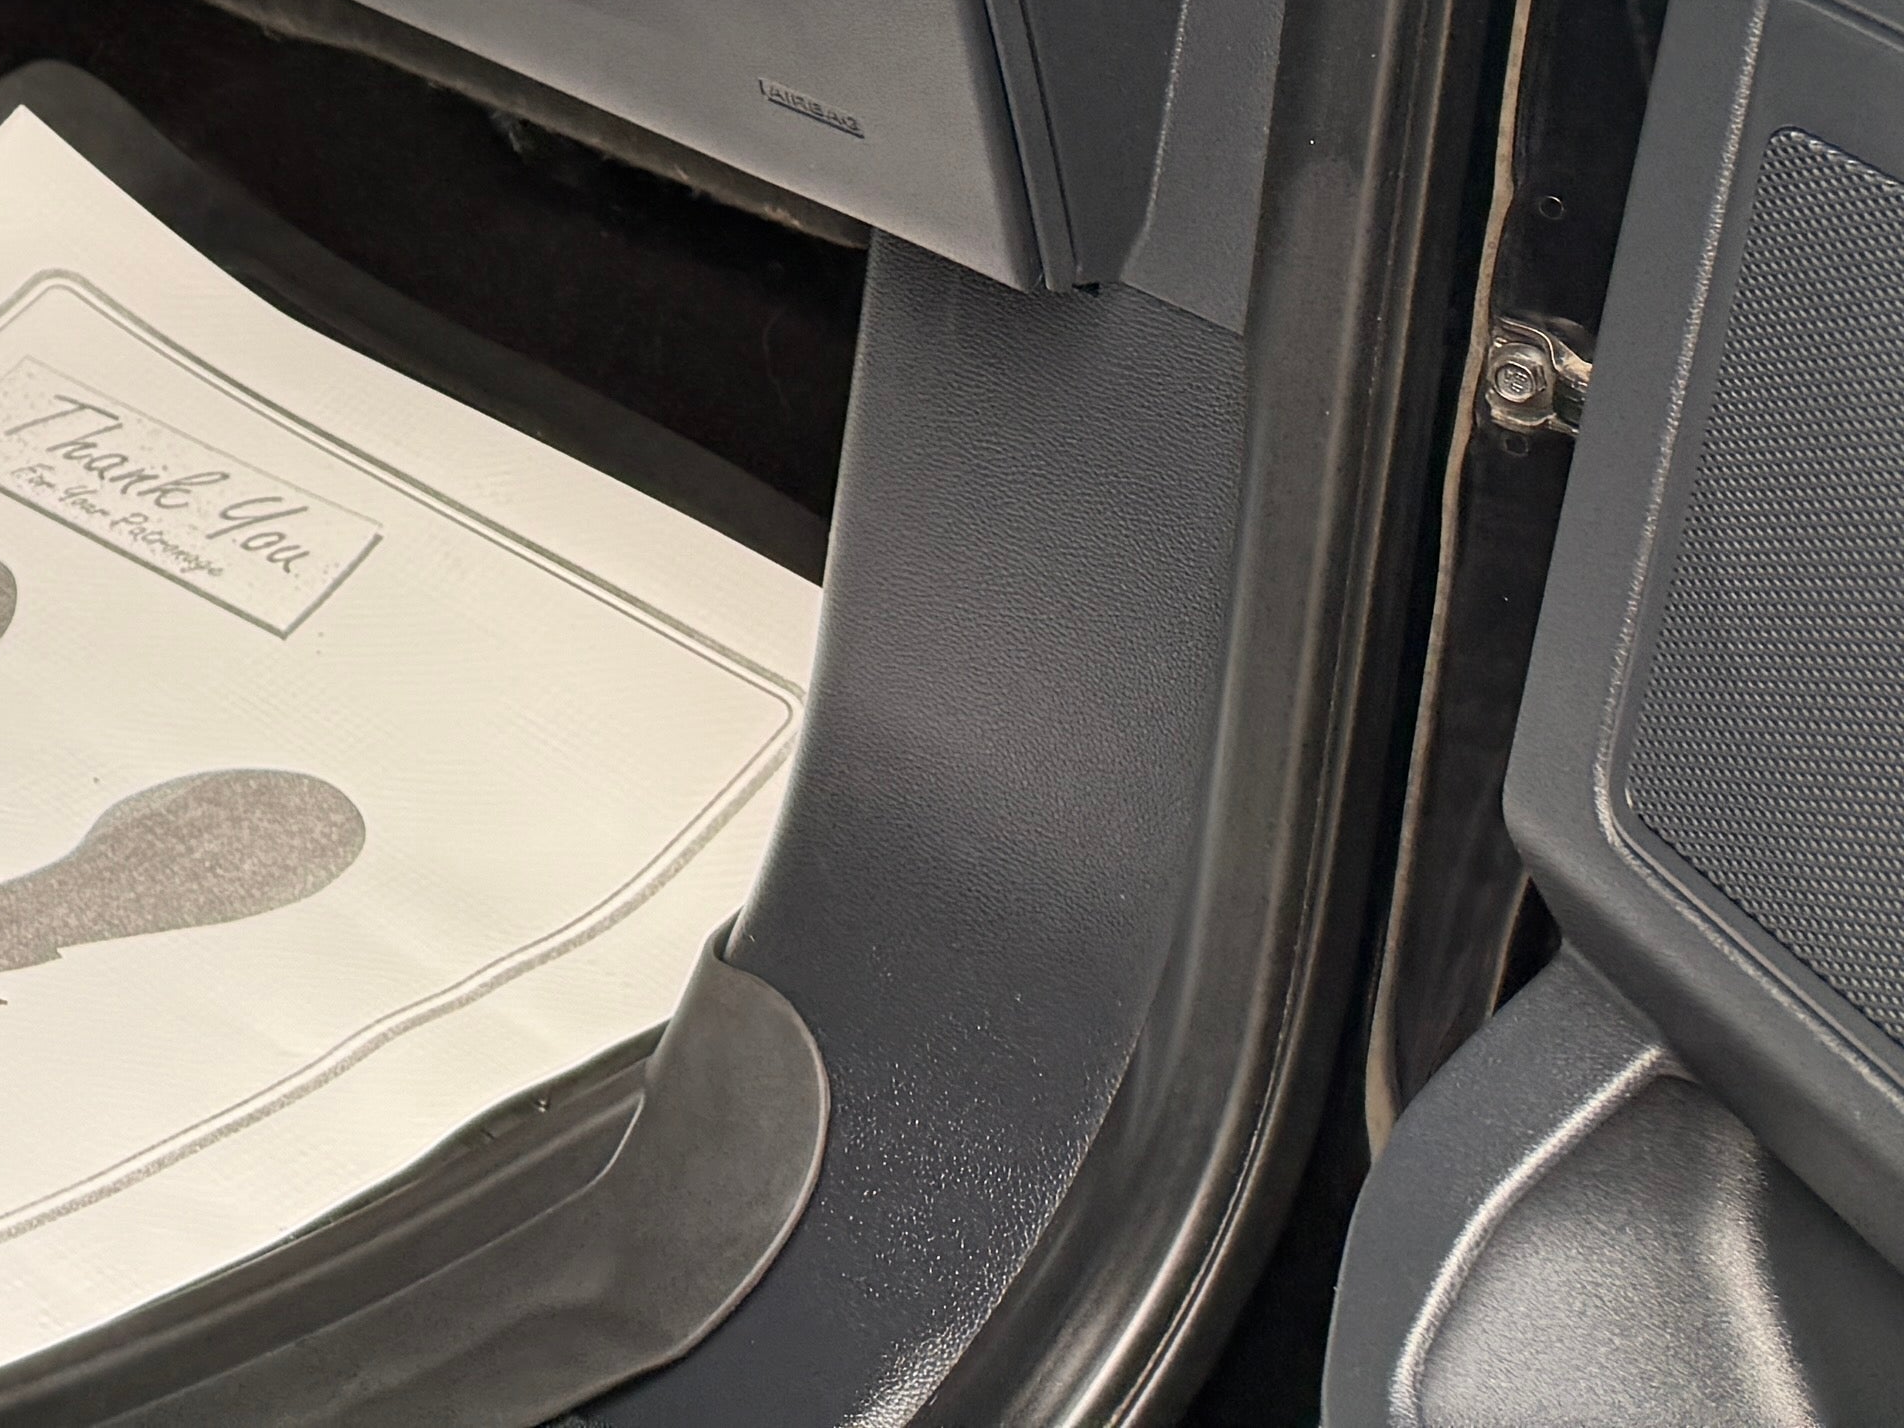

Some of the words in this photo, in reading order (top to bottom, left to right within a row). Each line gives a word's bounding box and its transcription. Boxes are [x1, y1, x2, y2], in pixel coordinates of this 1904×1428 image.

[768, 84, 860, 132] AIRBAG
[3, 393, 230, 510] Thank
[204, 496, 310, 575] You
[10, 462, 56, 489] For
[58, 484, 111, 517] Your
[109, 512, 224, 578] Patronage
